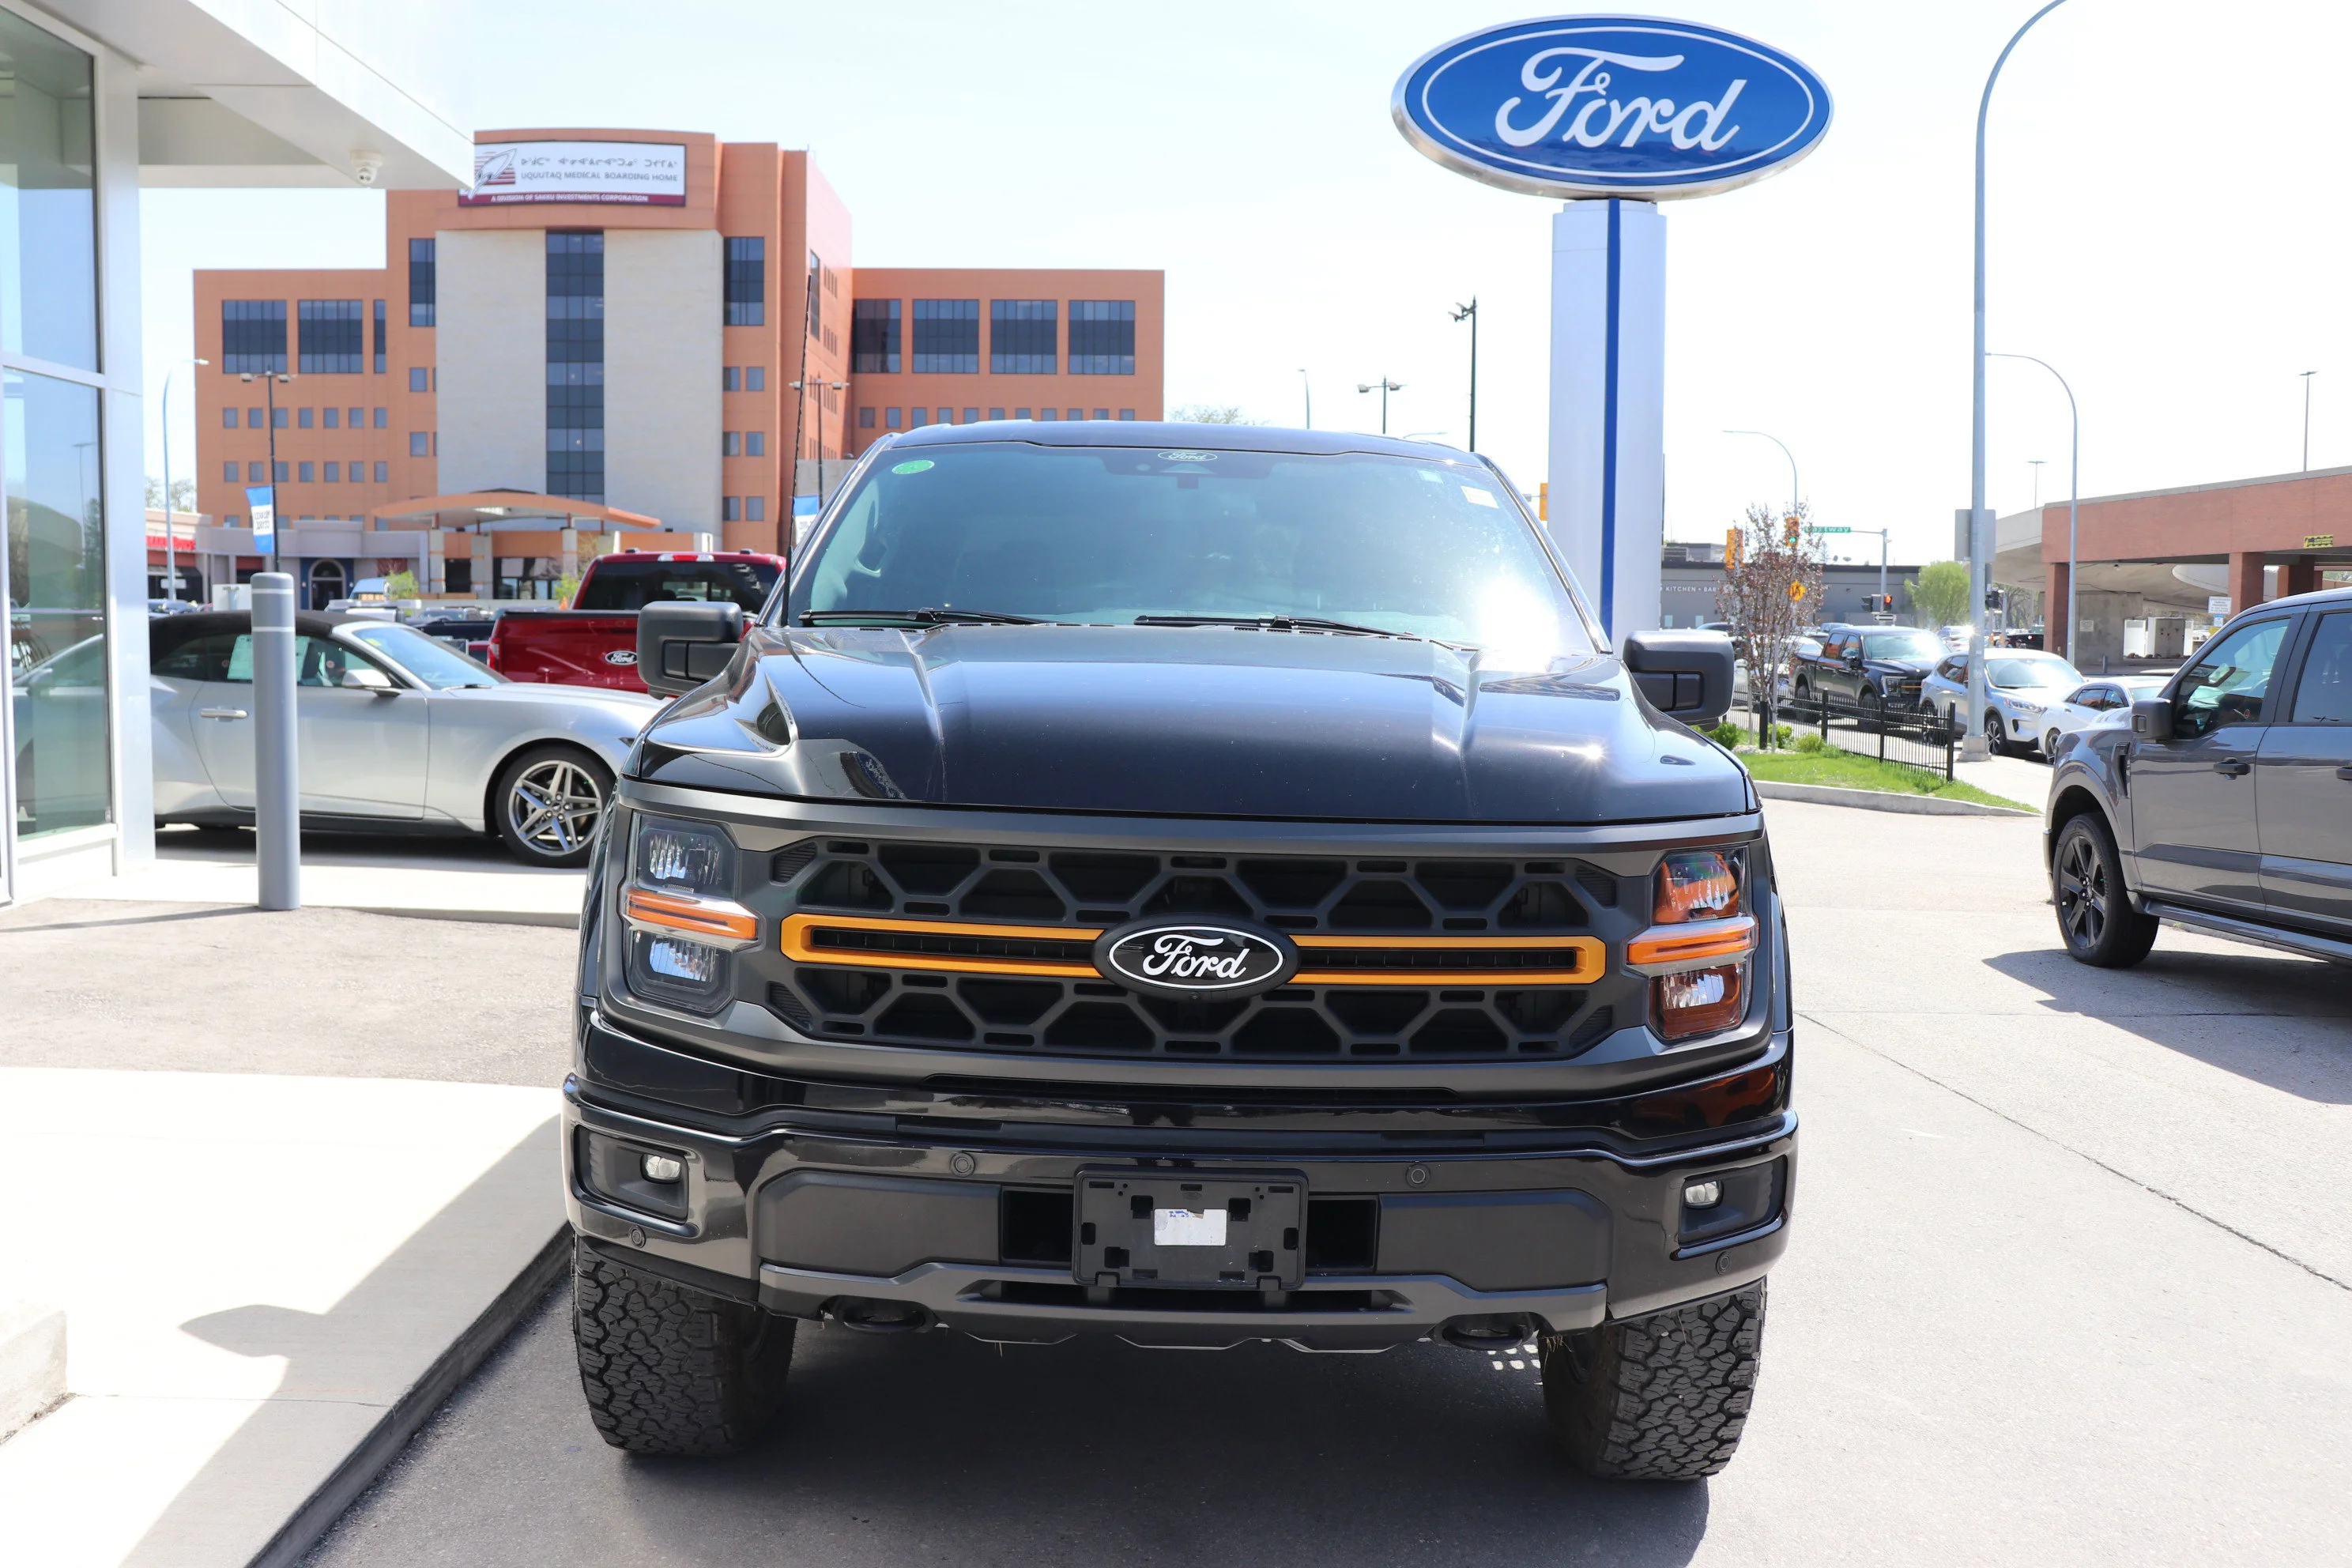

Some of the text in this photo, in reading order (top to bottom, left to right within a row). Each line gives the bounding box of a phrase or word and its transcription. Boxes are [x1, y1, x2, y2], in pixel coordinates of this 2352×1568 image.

[1495, 47, 1747, 151] Ford
[605, 172, 650, 181] BOARDING
[1168, 450, 1207, 460] Ford
[611, 652, 635, 662] Ford
[1142, 934, 1250, 978] Ford
